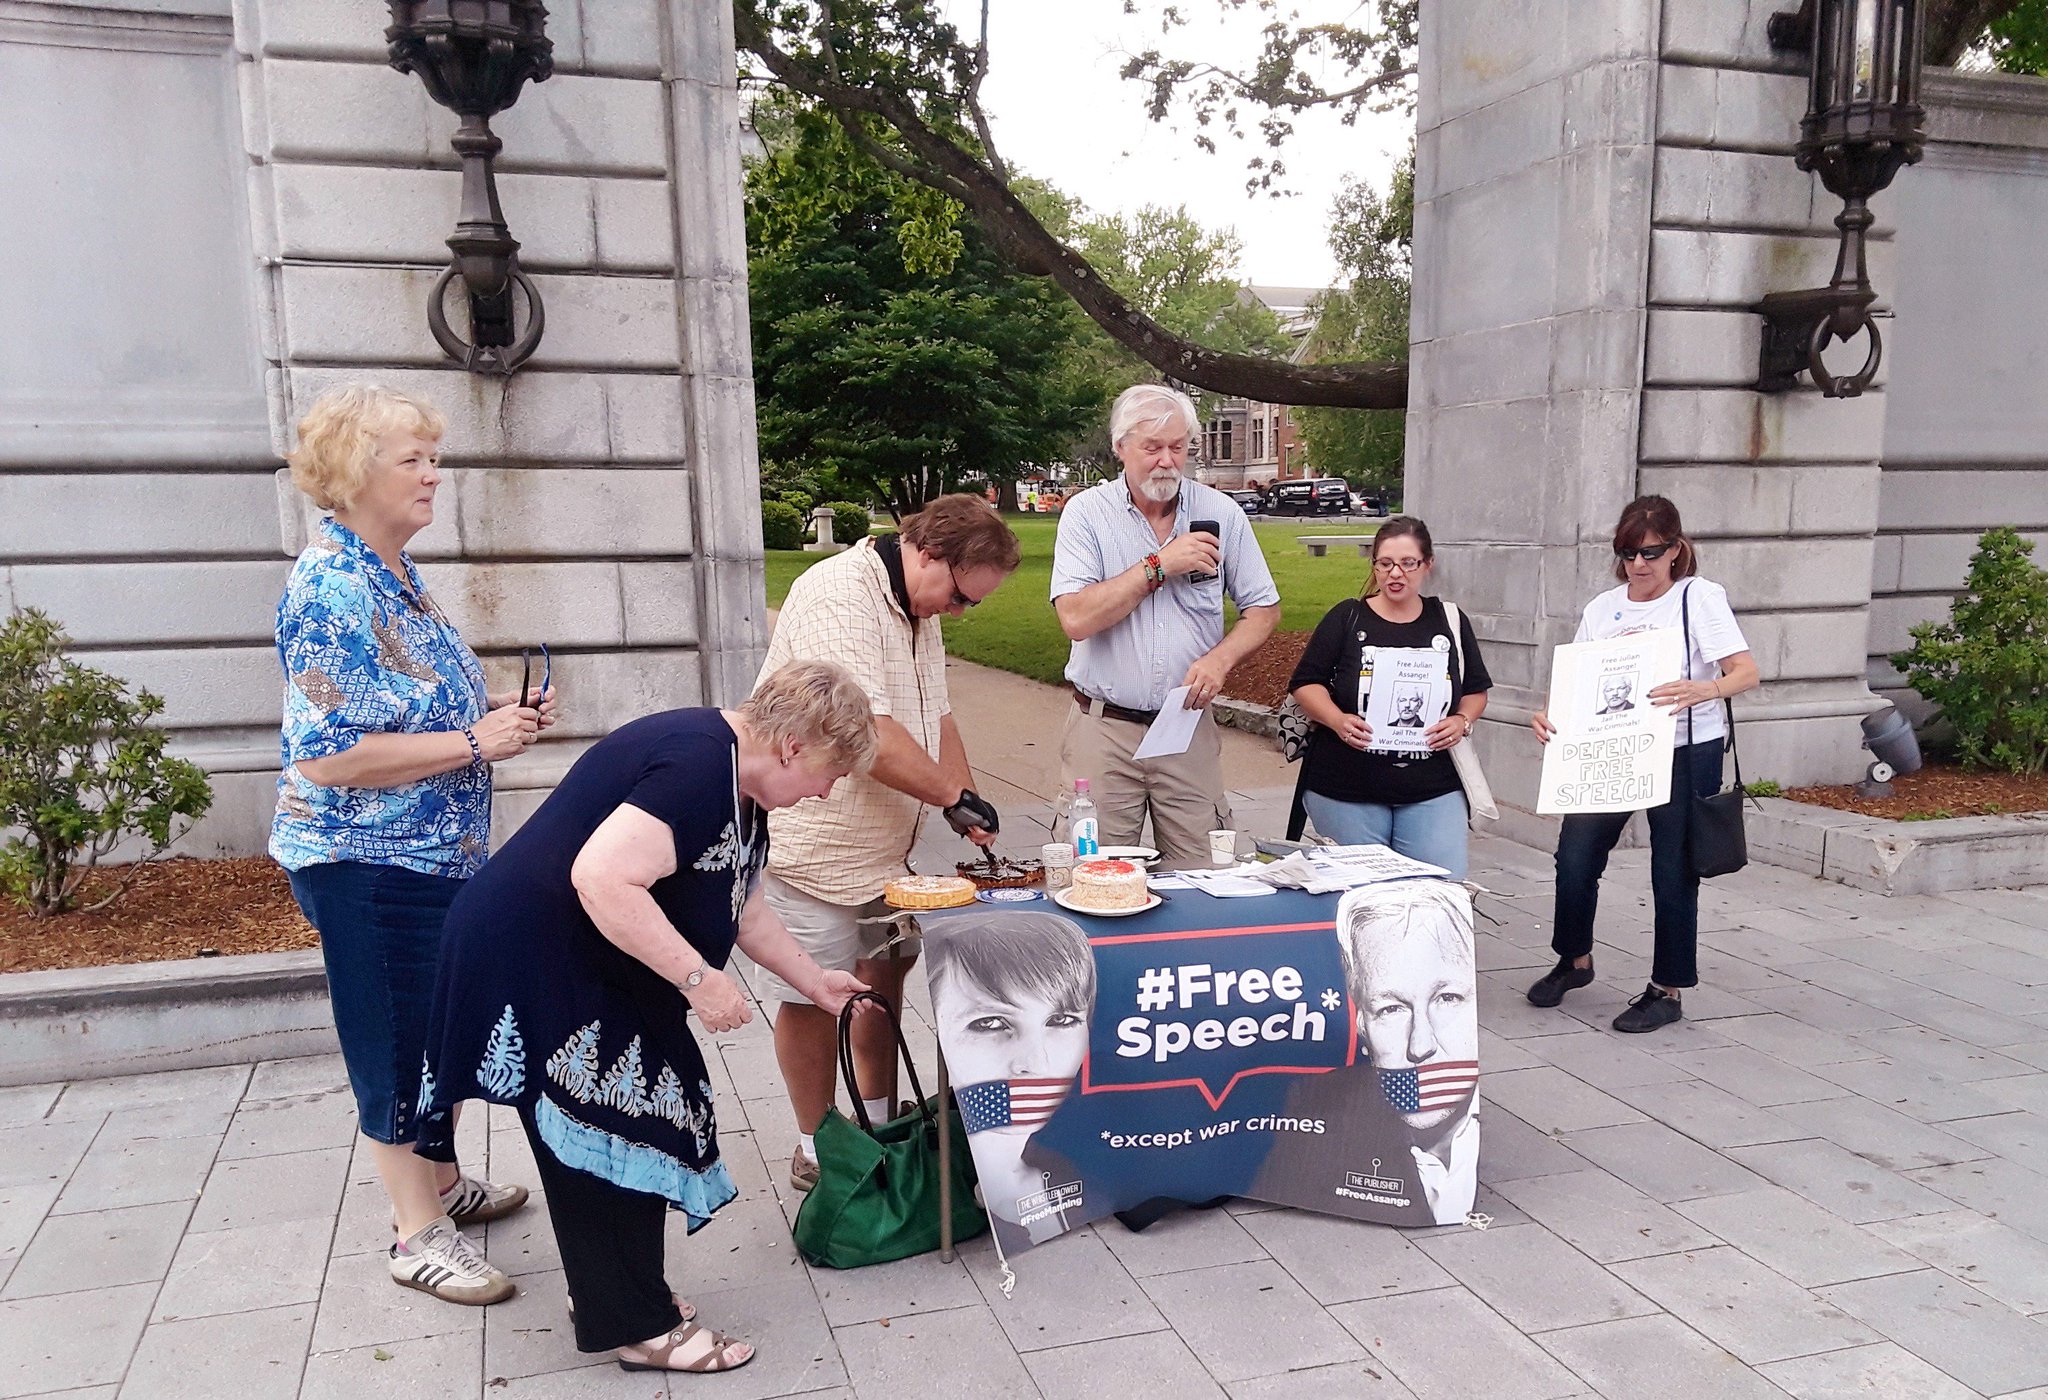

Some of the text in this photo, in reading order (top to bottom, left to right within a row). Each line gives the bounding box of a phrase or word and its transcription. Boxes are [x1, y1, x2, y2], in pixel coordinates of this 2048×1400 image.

[1413, 661, 1433, 669] Julian
[1619, 654, 1640, 662] Julian
[1398, 671, 1429, 680] Assange!
[1603, 663, 1637, 672] Assange!
[1601, 715, 1613, 723] Jail
[1562, 733, 1655, 762] DEFEND
[1579, 756, 1634, 782] FREE
[1555, 773, 1654, 807] SPEECH
[1136, 963, 1304, 1012] #Free
[1199, 1119, 1241, 1141] war
[1245, 1114, 1326, 1135] crimes
[1351, 1175, 1399, 1191] THE PUBLISHER
[1020, 1200, 1031, 1211] THE
[1335, 1187, 1411, 1207] #FreeAssange
[1020, 1197, 1083, 1227] #FreeManning
